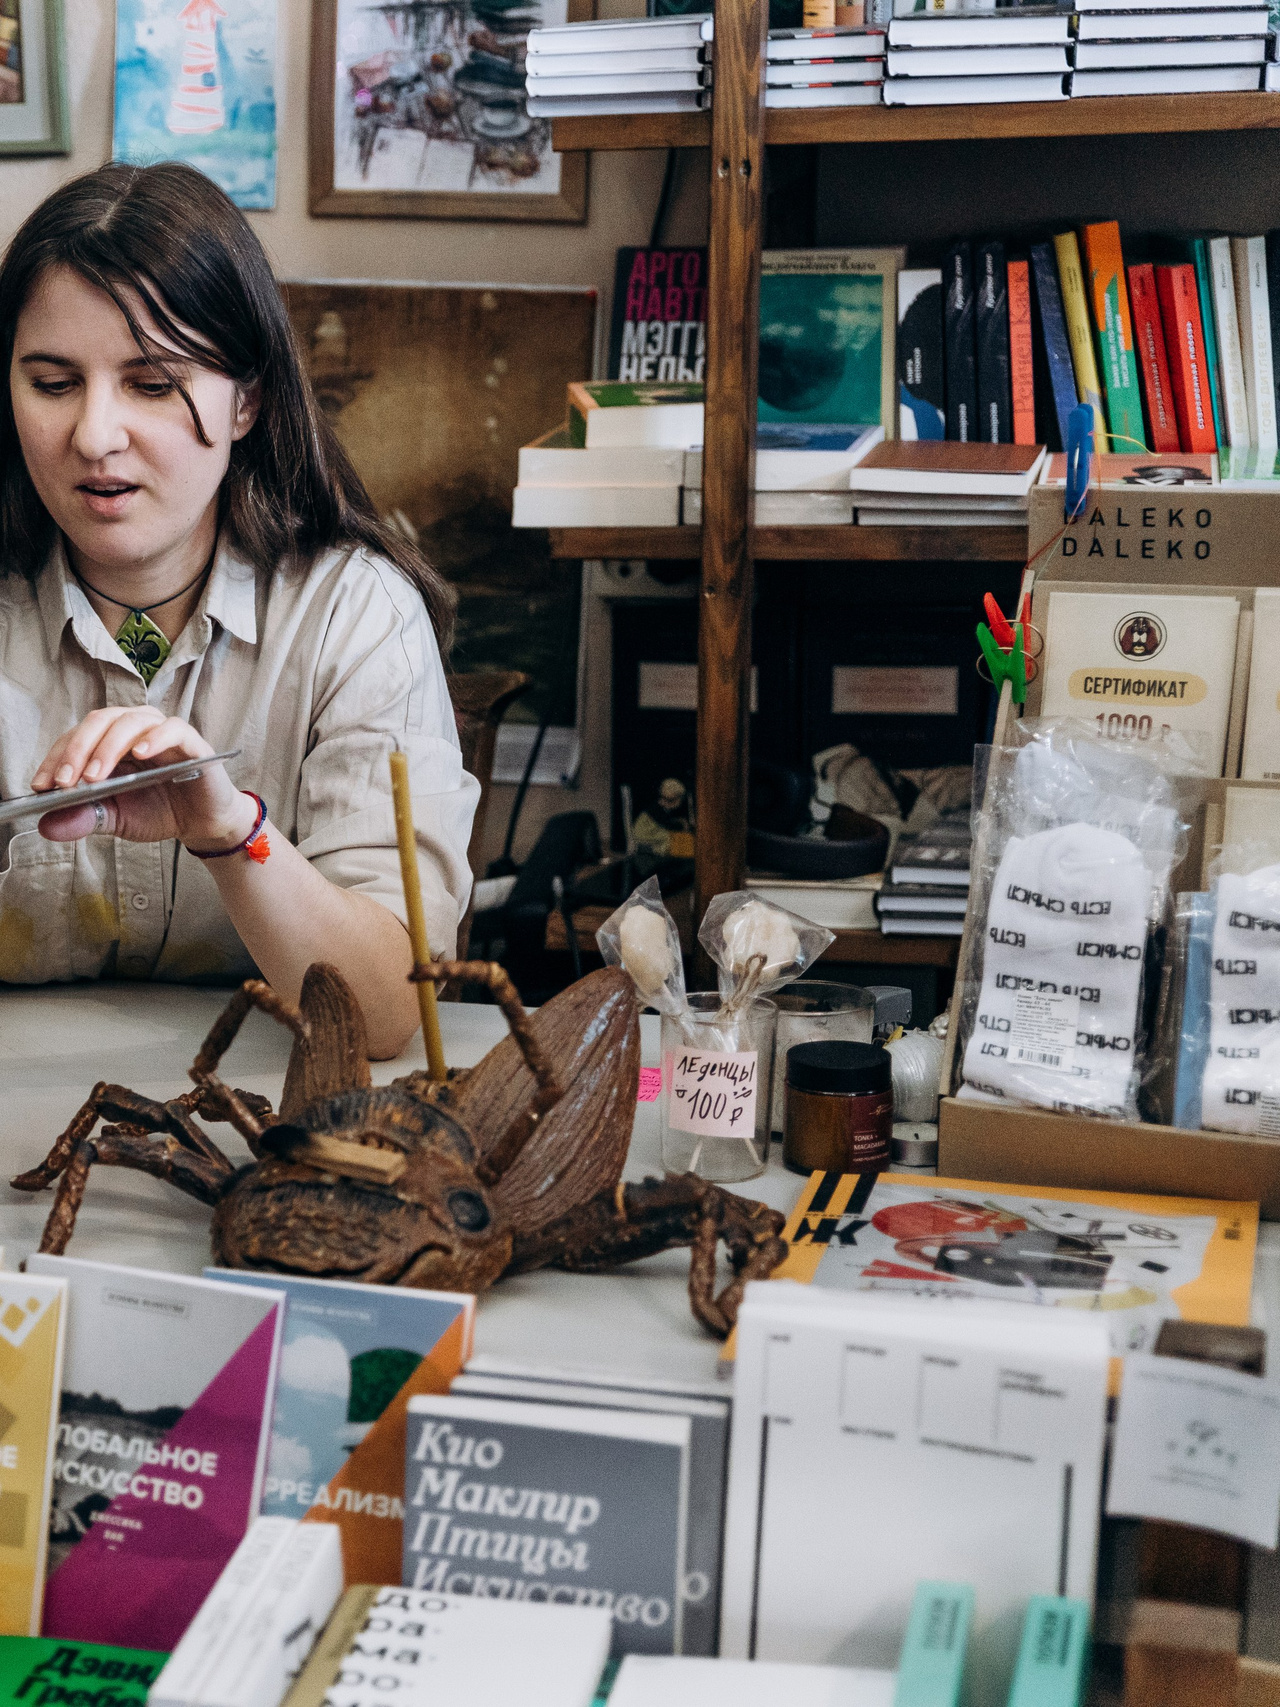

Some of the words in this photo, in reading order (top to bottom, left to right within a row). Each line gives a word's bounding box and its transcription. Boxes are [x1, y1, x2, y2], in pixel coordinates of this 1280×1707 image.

[628, 252, 700, 286] АРГО
[625, 287, 708, 320] НАВТ
[1061, 537, 1212, 560] DALEKO
[1083, 676, 1188, 699] СЕРТИФИКАТ
[1096, 712, 1153, 741] 1000
[1006, 883, 1065, 913] СМЫСЛ
[1071, 899, 1111, 916] ЕСТЬ
[1229, 910, 1280, 932] МЫСЛ
[989, 926, 1026, 948] ЕСТЬ
[1076, 942, 1142, 960] СМЫСЛ
[1215, 958, 1257, 976] ЕСТЬ
[980, 1014, 1011, 1032] СТЬ
[1076, 1031, 1131, 1051] СМЫС
[687, 1088, 728, 1121] 100
[57, 1422, 219, 1478] ЛОБАЛЬНОЕ
[413, 1420, 505, 1470] Кио
[411, 1466, 602, 1535] Маклир
[409, 1512, 592, 1577] Птицы
[33, 1646, 156, 1688] Дэви
